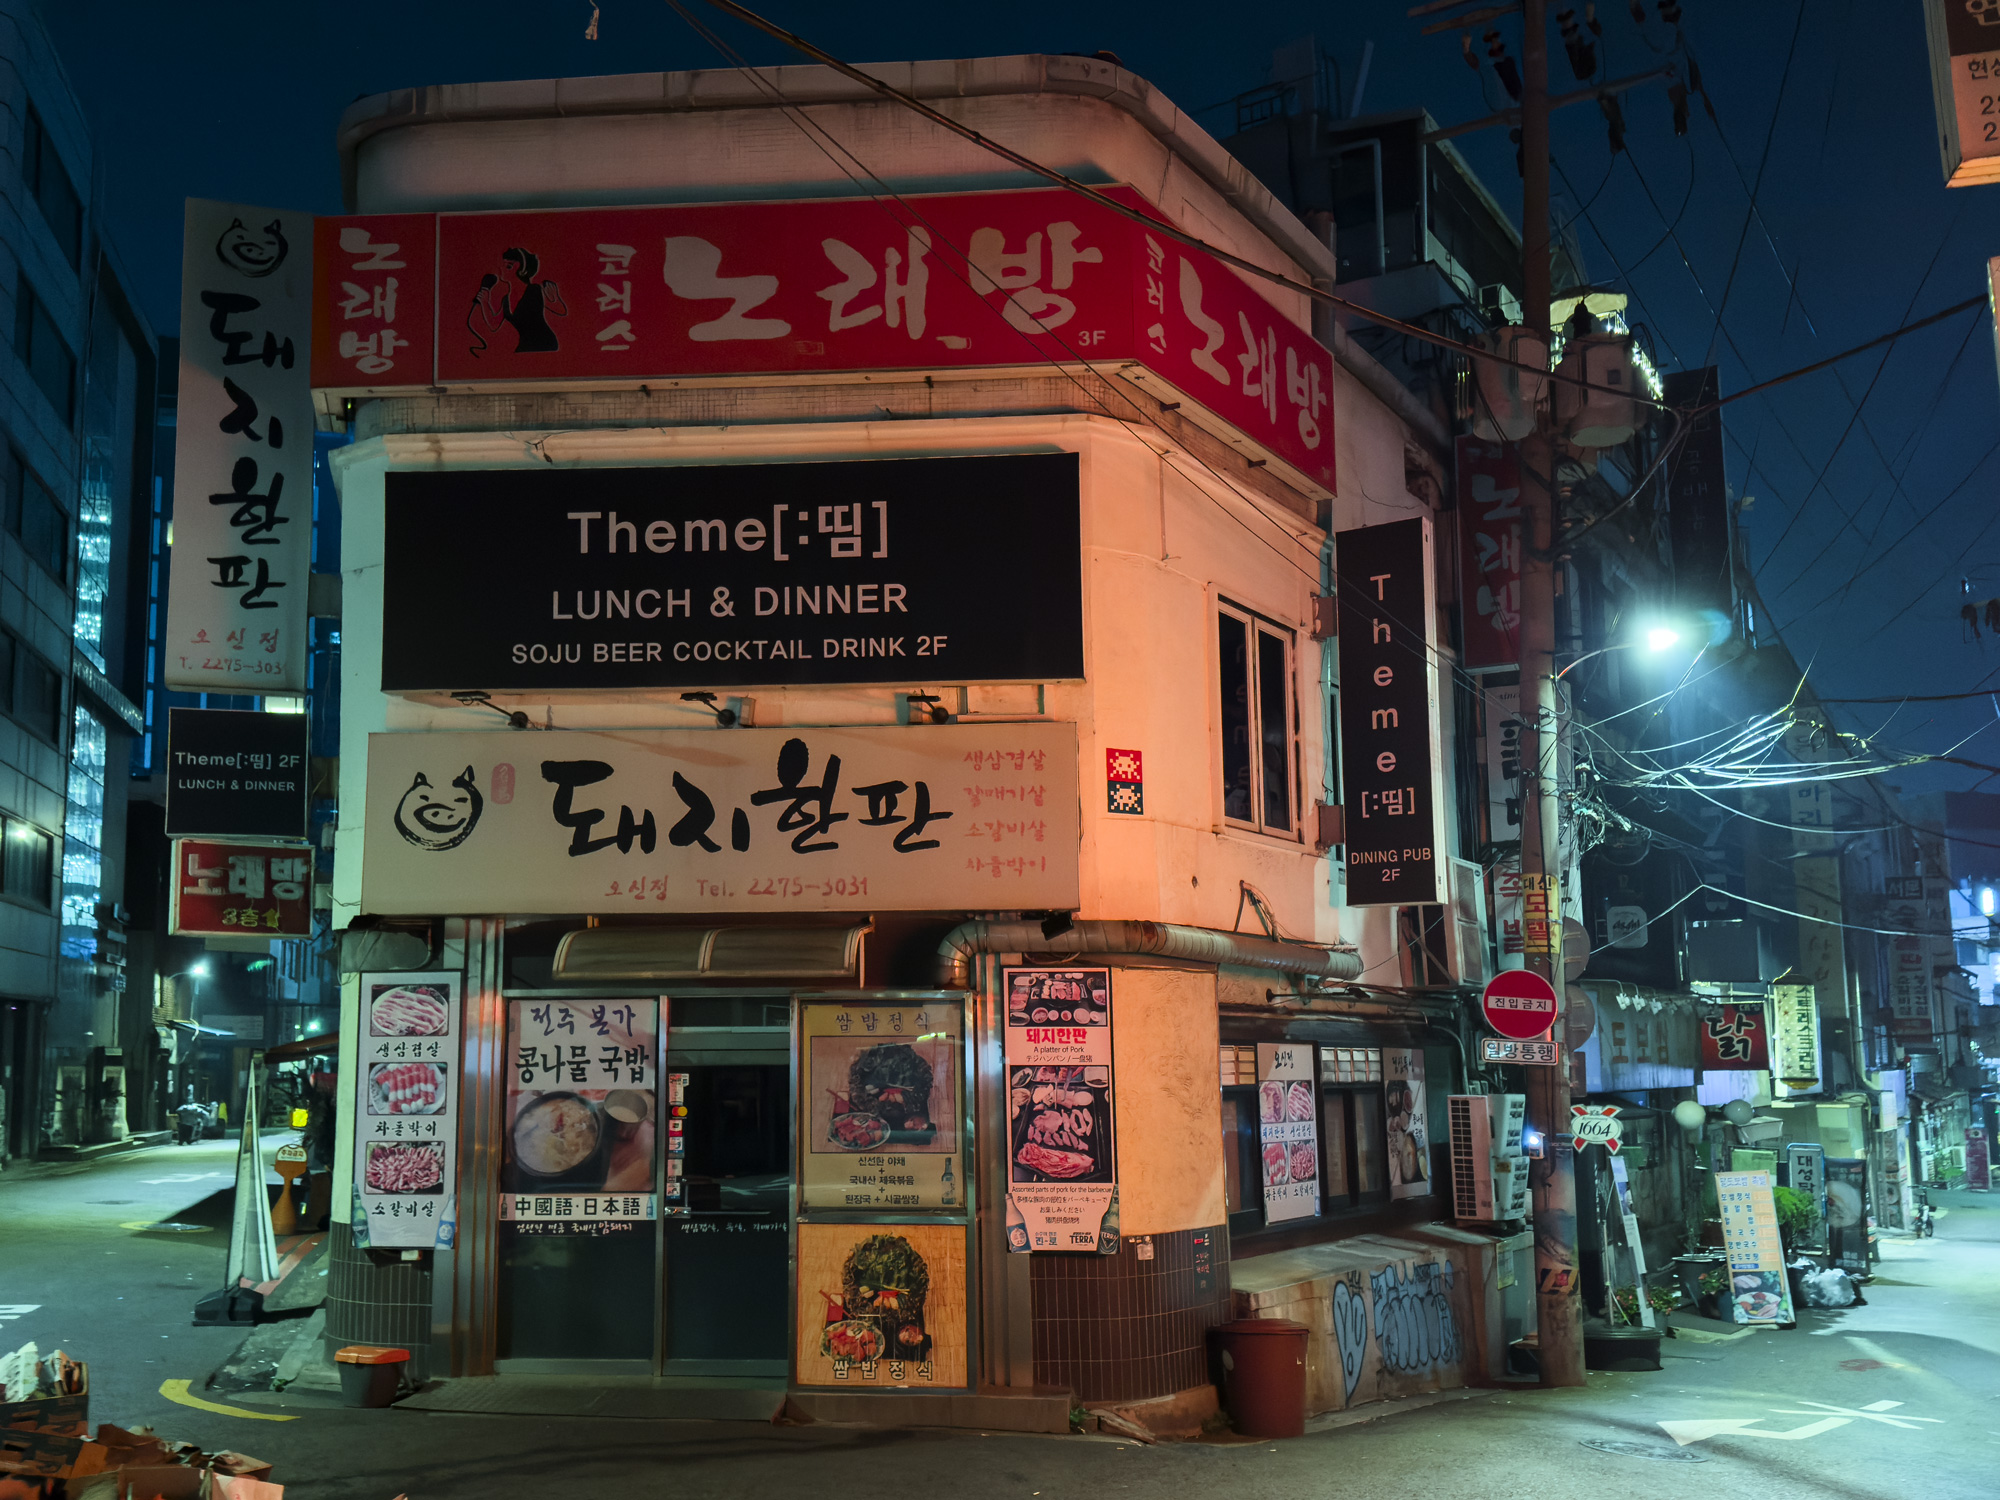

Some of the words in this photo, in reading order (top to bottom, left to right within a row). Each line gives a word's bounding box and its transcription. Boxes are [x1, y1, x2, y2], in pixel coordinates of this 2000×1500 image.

[663, 221, 1103, 342] 노래방
[338, 227, 408, 374] 노래방
[595, 243, 637, 351] 코러스
[1145, 232, 1167, 355] 코러스
[1078, 330, 1107, 347] 3F
[1179, 255, 1327, 450] 노래방
[200, 289, 295, 609] 돼지한판
[553, 588, 691, 620] LUNCH
[709, 586, 736, 617] &
[754, 583, 908, 617] DINNER
[512, 643, 581, 664] SOJU
[593, 643, 662, 663] BEER
[673, 639, 812, 661] COCKTAIL
[823, 637, 906, 658] DRINK
[916, 636, 948, 655] 2F
[202, 658, 284, 675] 2275-303
[1370, 573, 1399, 773] Theme
[279, 755, 300, 768] 2F
[964, 750, 1046, 771] 생삼겹살
[178, 778, 225, 790] LUNCH
[230, 779, 239, 790] &
[245, 779, 295, 792] DINNER
[541, 738, 953, 857] 돼지한판
[964, 785, 1046, 807] 갈매기살
[965, 820, 1046, 842] 소갈비살
[965, 856, 1047, 877] 차돌박이
[1351, 849, 1399, 865] DINING
[1403, 848, 1431, 864] PUB
[183, 853, 310, 901] 노래방
[1382, 869, 1400, 882] 2F
[605, 876, 668, 900] 오신정
[698, 879, 734, 897] Tel.
[748, 877, 868, 898] 2275-3031
[1494, 997, 1548, 1011] 진입금지
[531, 1004, 575, 1036] 전주
[590, 1004, 636, 1036] 본가
[1026, 1028, 1087, 1044] 돼지한판
[1706, 1012, 1756, 1063] 닭
[376, 1041, 442, 1058] 생삼겹살
[1040, 1046, 1060, 1055] platter
[1486, 1042, 1553, 1061] 일방통행
[515, 1045, 591, 1084] 콩나물
[598, 1045, 650, 1083] 국밥
[375, 1120, 437, 1136] 차돌박이
[1579, 1121, 1611, 1137] 1664
[858, 1156, 885, 1167] 신선한
[887, 1156, 906, 1167] 야채
[849, 1175, 876, 1185] 국내산
[879, 1175, 915, 1186] 제육볶음
[1036, 1186, 1049, 1194] parts
[1057, 1186, 1068, 1194] pork
[372, 1200, 437, 1217] 소갈비살
[515, 1197, 641, 1217] 中國語·日本語
[845, 1194, 871, 1205] 된장국
[1069, 1235, 1094, 1244] TERRA
[833, 1360, 933, 1381] 쌈밥정식
